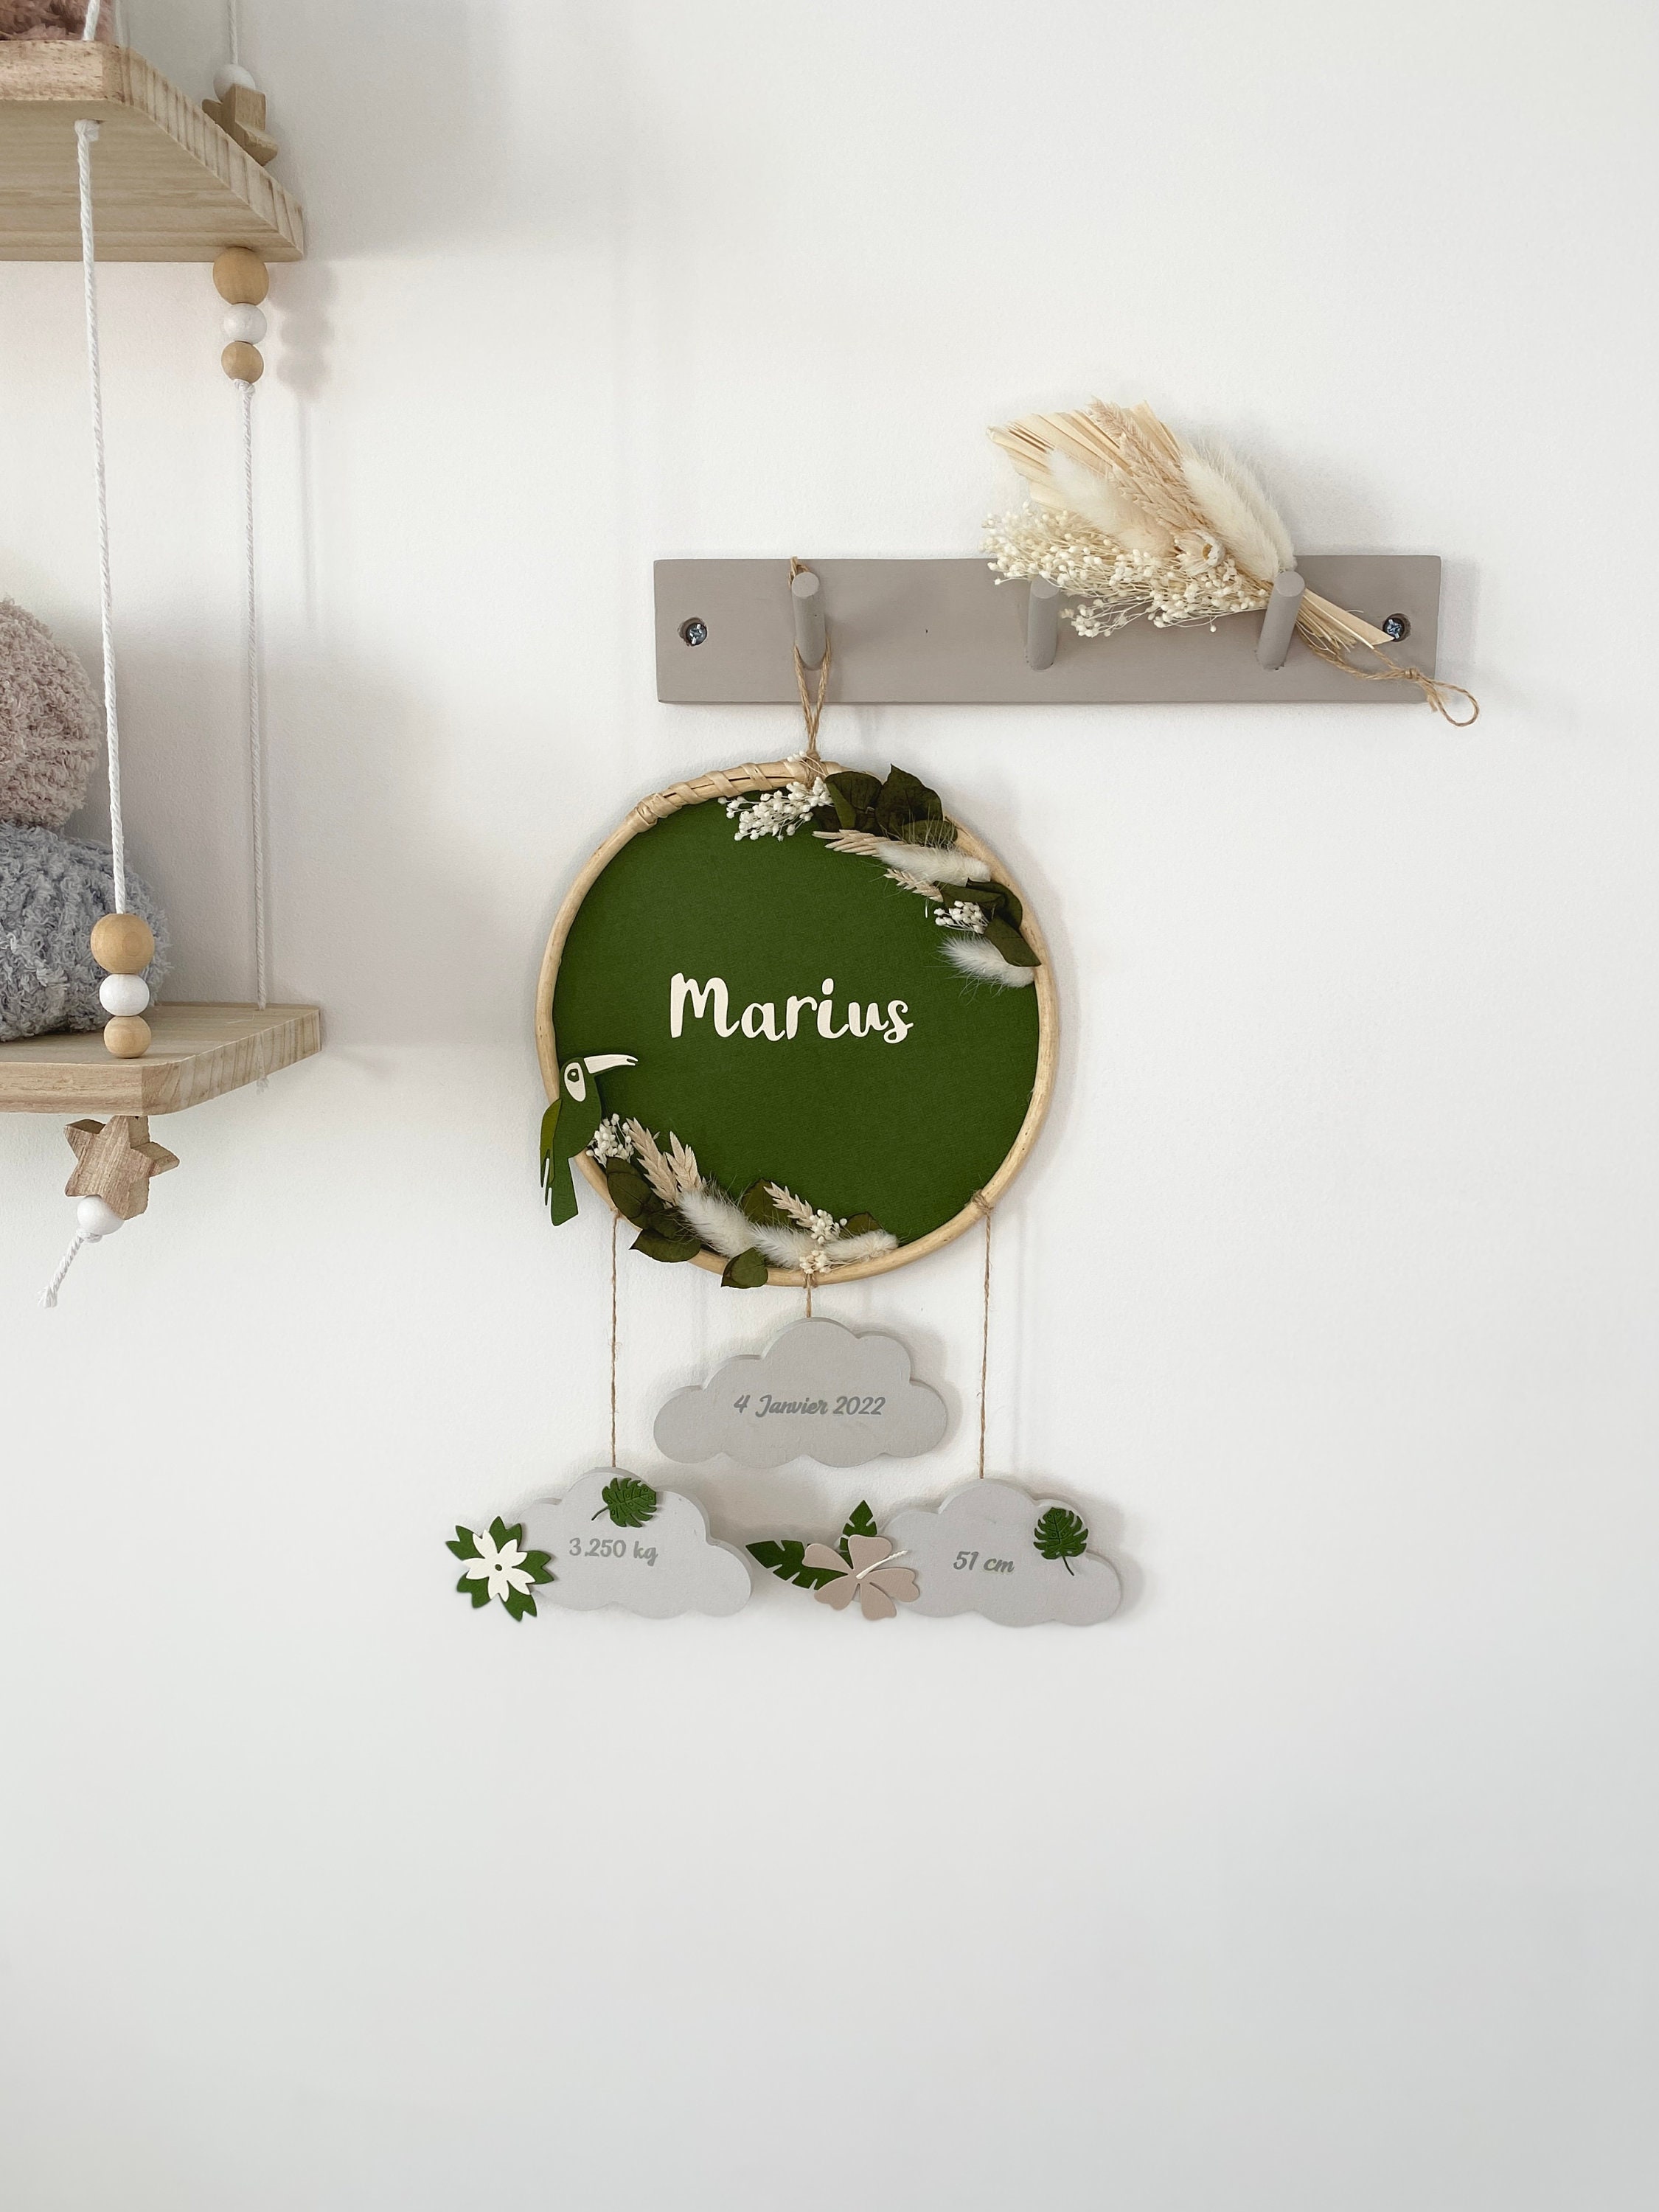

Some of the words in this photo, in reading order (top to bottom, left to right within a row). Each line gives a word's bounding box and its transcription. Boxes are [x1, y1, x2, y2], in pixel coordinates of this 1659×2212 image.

[670, 972, 914, 1044] Marius
[733, 1394, 751, 1414] 4
[754, 1394, 829, 1418] Janvier
[832, 1396, 886, 1415] 2022
[568, 1537, 627, 1558] 3.250
[633, 1540, 658, 1567] kg
[953, 1551, 980, 1571] 51
[983, 1558, 1015, 1573] cm
